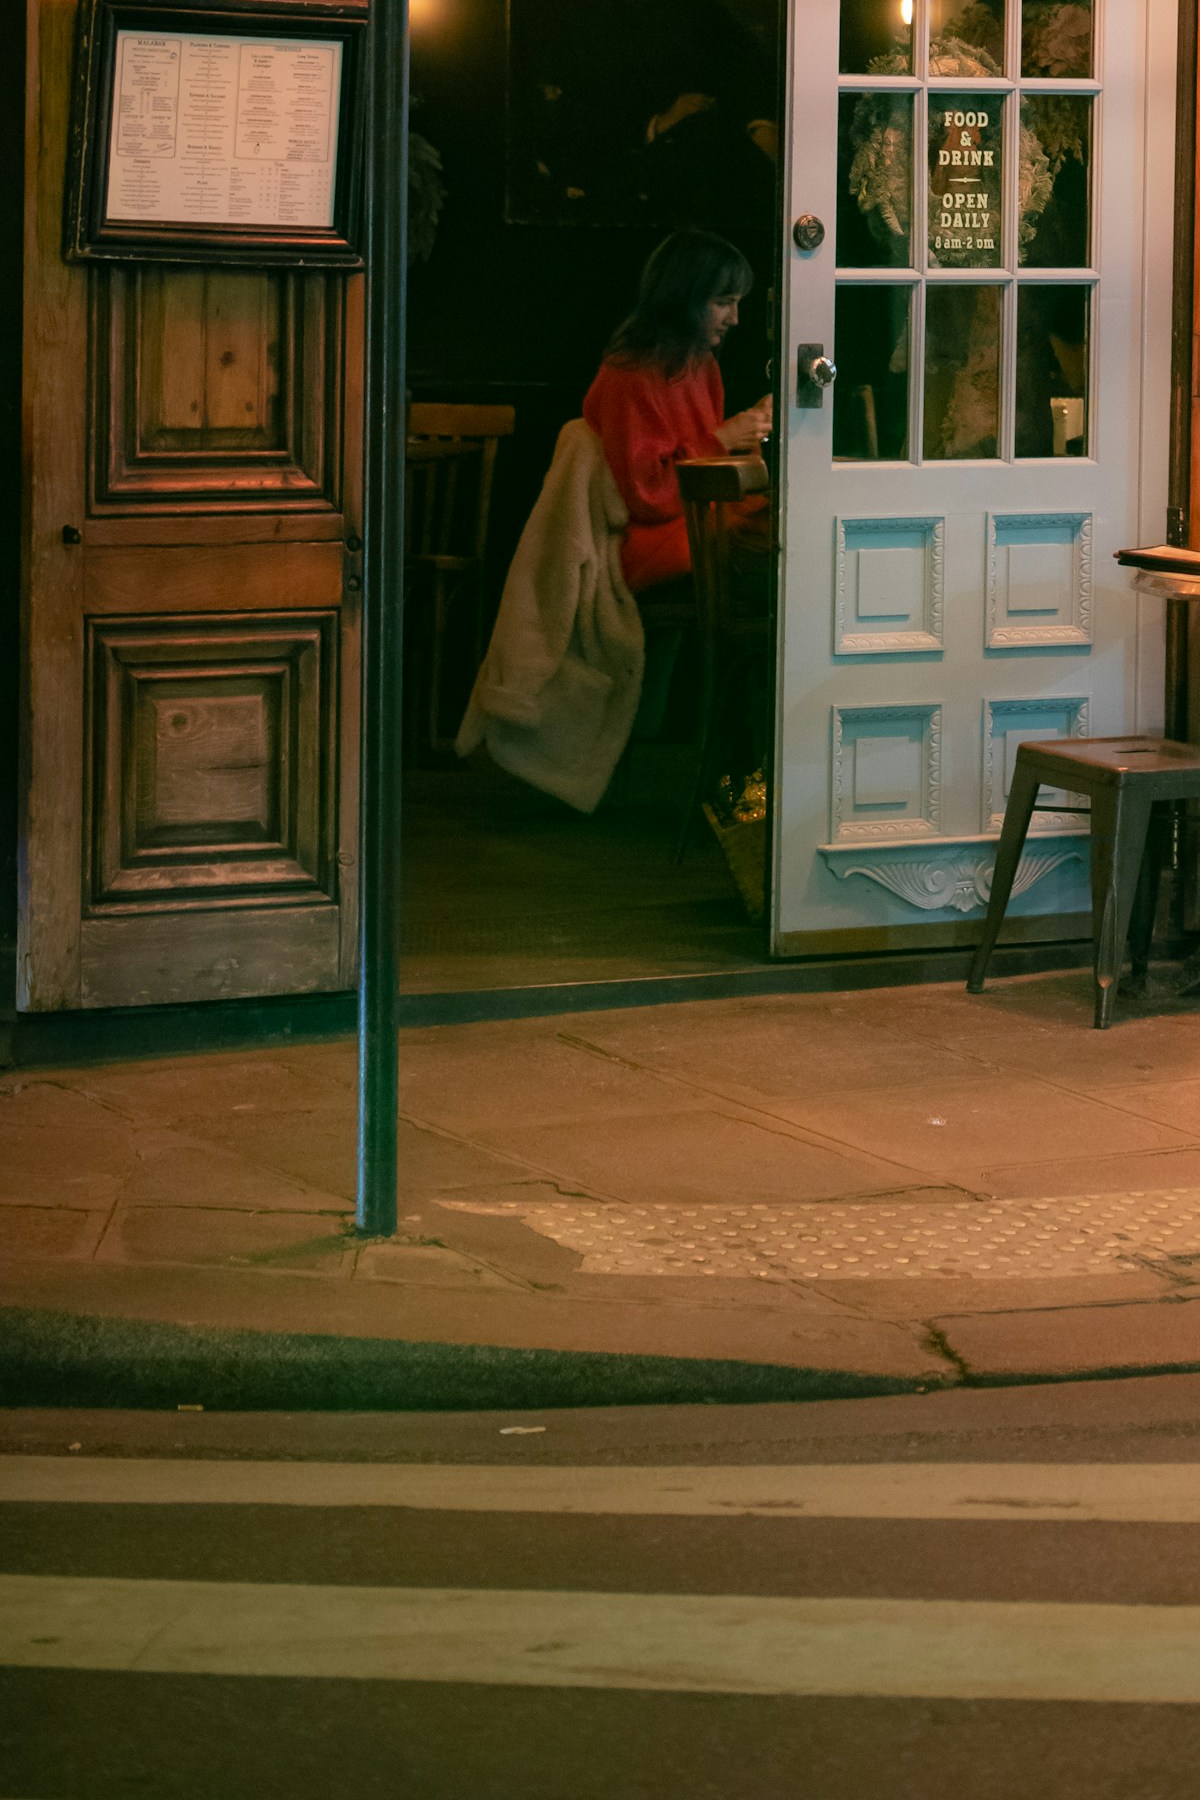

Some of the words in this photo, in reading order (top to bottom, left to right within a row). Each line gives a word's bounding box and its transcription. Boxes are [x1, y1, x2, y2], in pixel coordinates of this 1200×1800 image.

[944, 111, 989, 128] FOOD
[960, 130, 972, 147] &
[939, 150, 994, 166] DRINK
[942, 193, 989, 209] OPEN
[940, 212, 990, 228] DAILY
